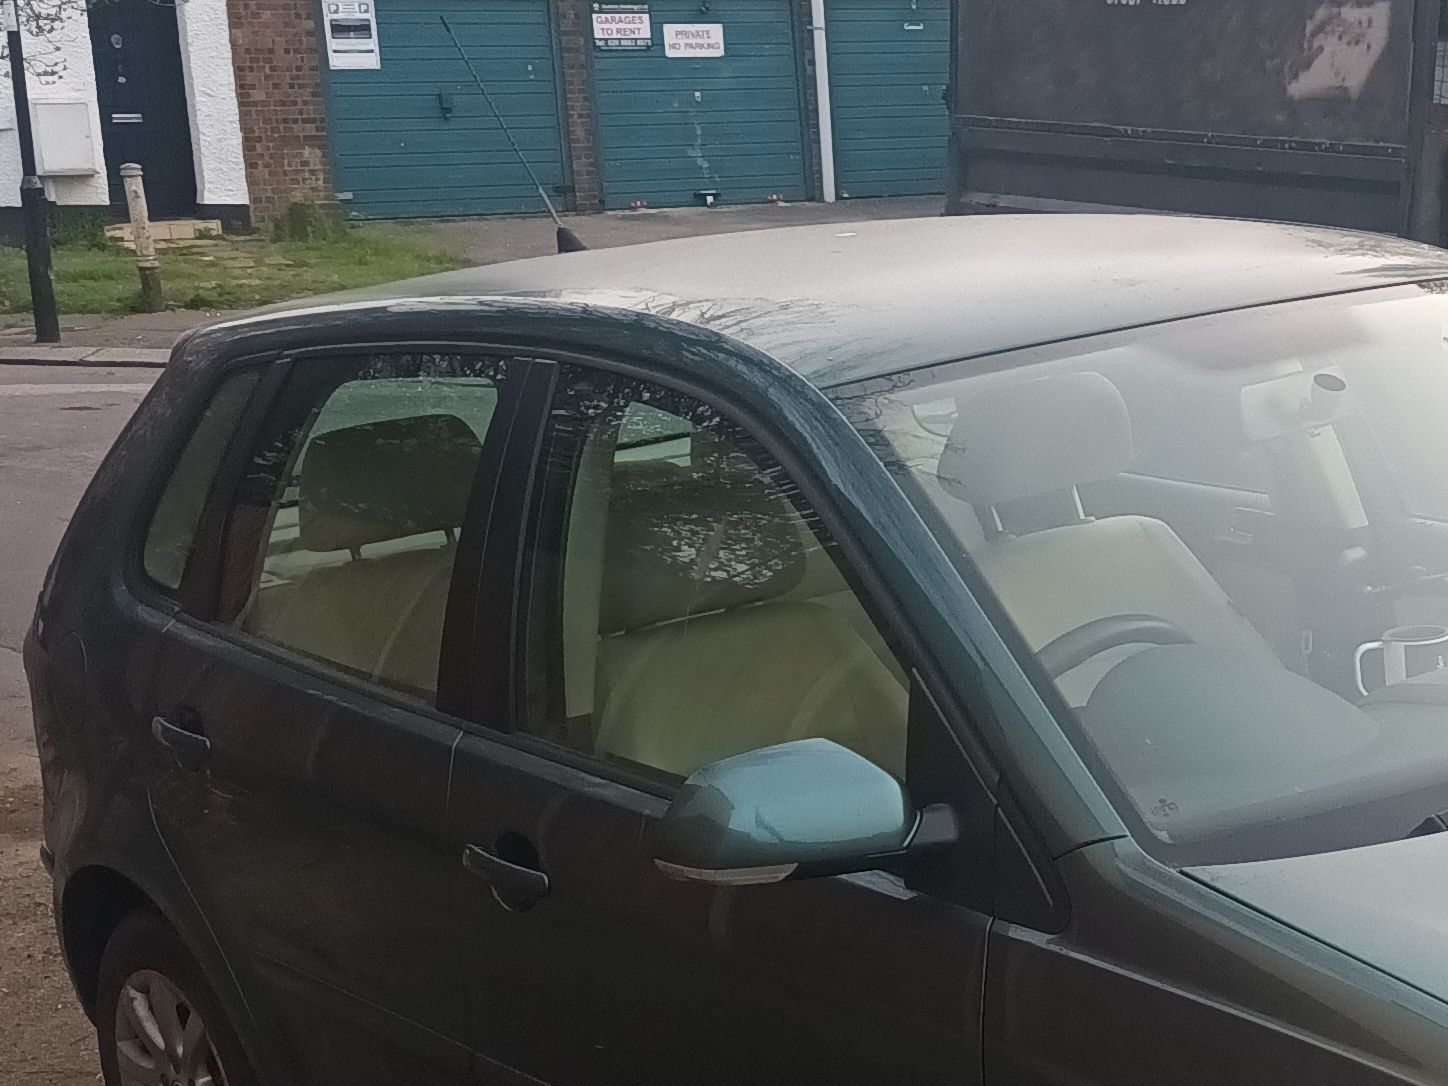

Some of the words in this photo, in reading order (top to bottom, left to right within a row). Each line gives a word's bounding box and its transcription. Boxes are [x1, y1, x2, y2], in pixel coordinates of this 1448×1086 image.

[595, 15, 644, 24] GARAGES
[600, 28, 613, 36] TO
[616, 27, 641, 36] RENT
[675, 30, 711, 39] PRIVATE
[684, 42, 720, 50] PARKING
